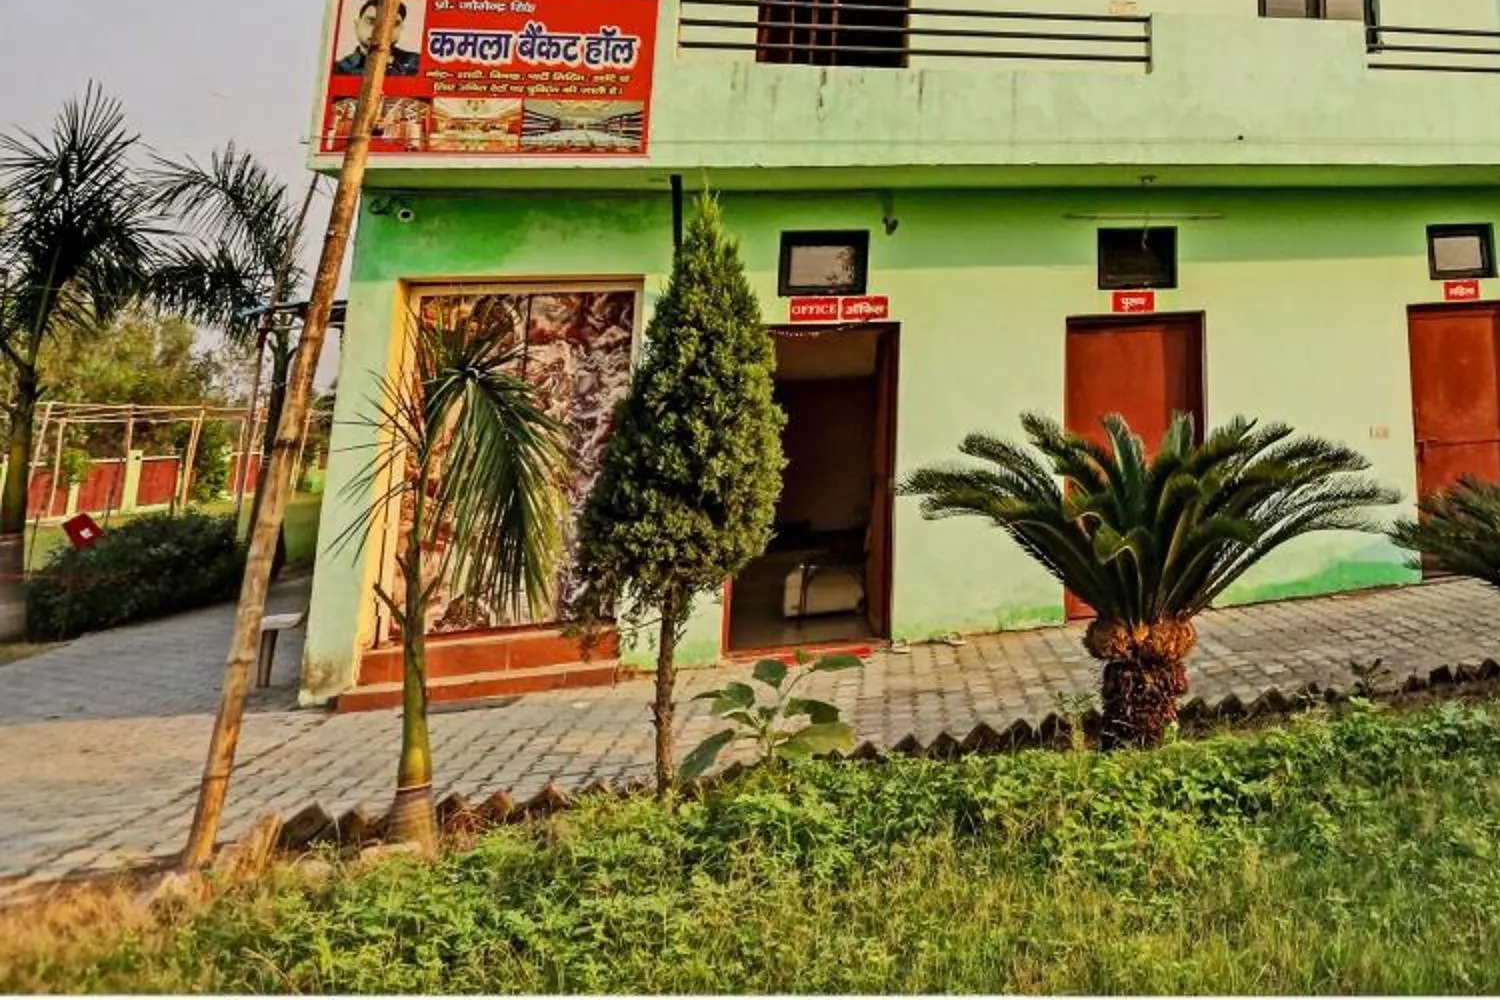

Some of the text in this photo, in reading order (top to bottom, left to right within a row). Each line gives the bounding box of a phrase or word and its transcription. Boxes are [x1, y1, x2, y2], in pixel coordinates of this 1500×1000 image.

[429, 23, 637, 65] कमला बैंकट हॉल
[792, 303, 837, 316] OFFICE
